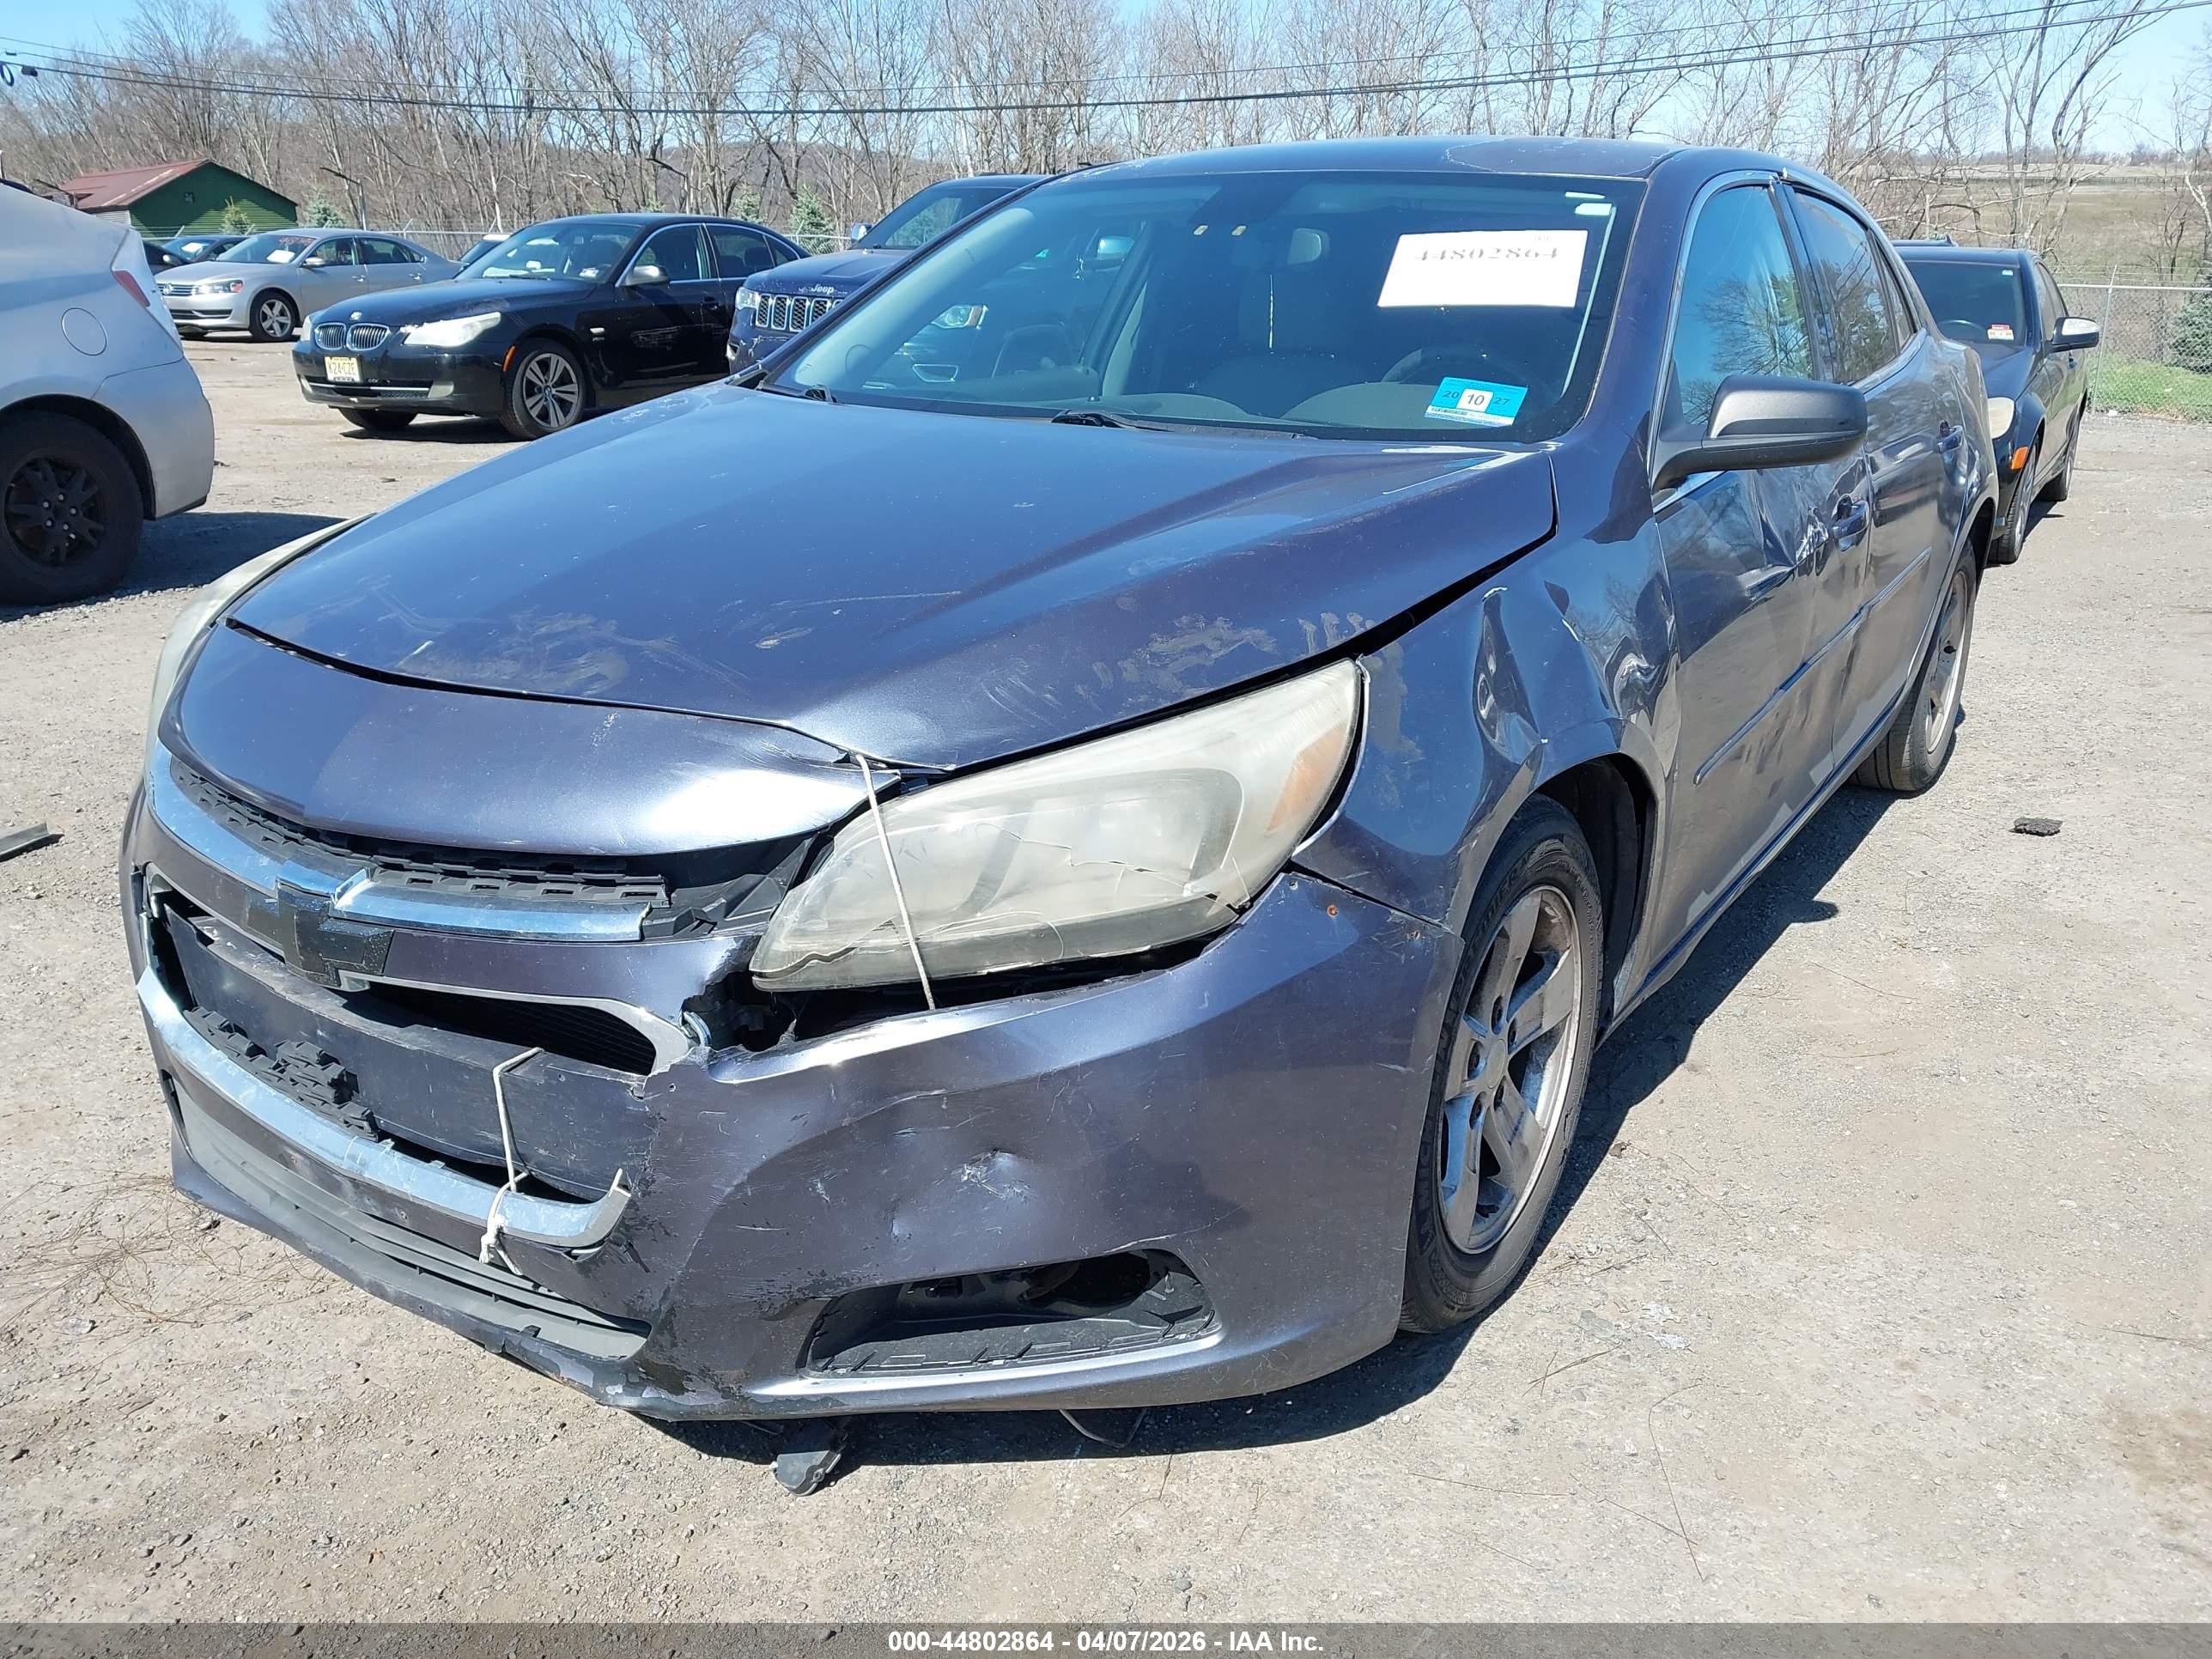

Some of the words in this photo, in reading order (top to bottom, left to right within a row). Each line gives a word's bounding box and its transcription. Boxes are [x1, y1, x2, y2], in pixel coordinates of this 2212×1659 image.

[1413, 247, 1559, 261] 44802864
[811, 283, 835, 295] Jeep
[1442, 389, 1461, 399] 20
[1466, 393, 1486, 406] 10
[1492, 397, 1511, 406] 27
